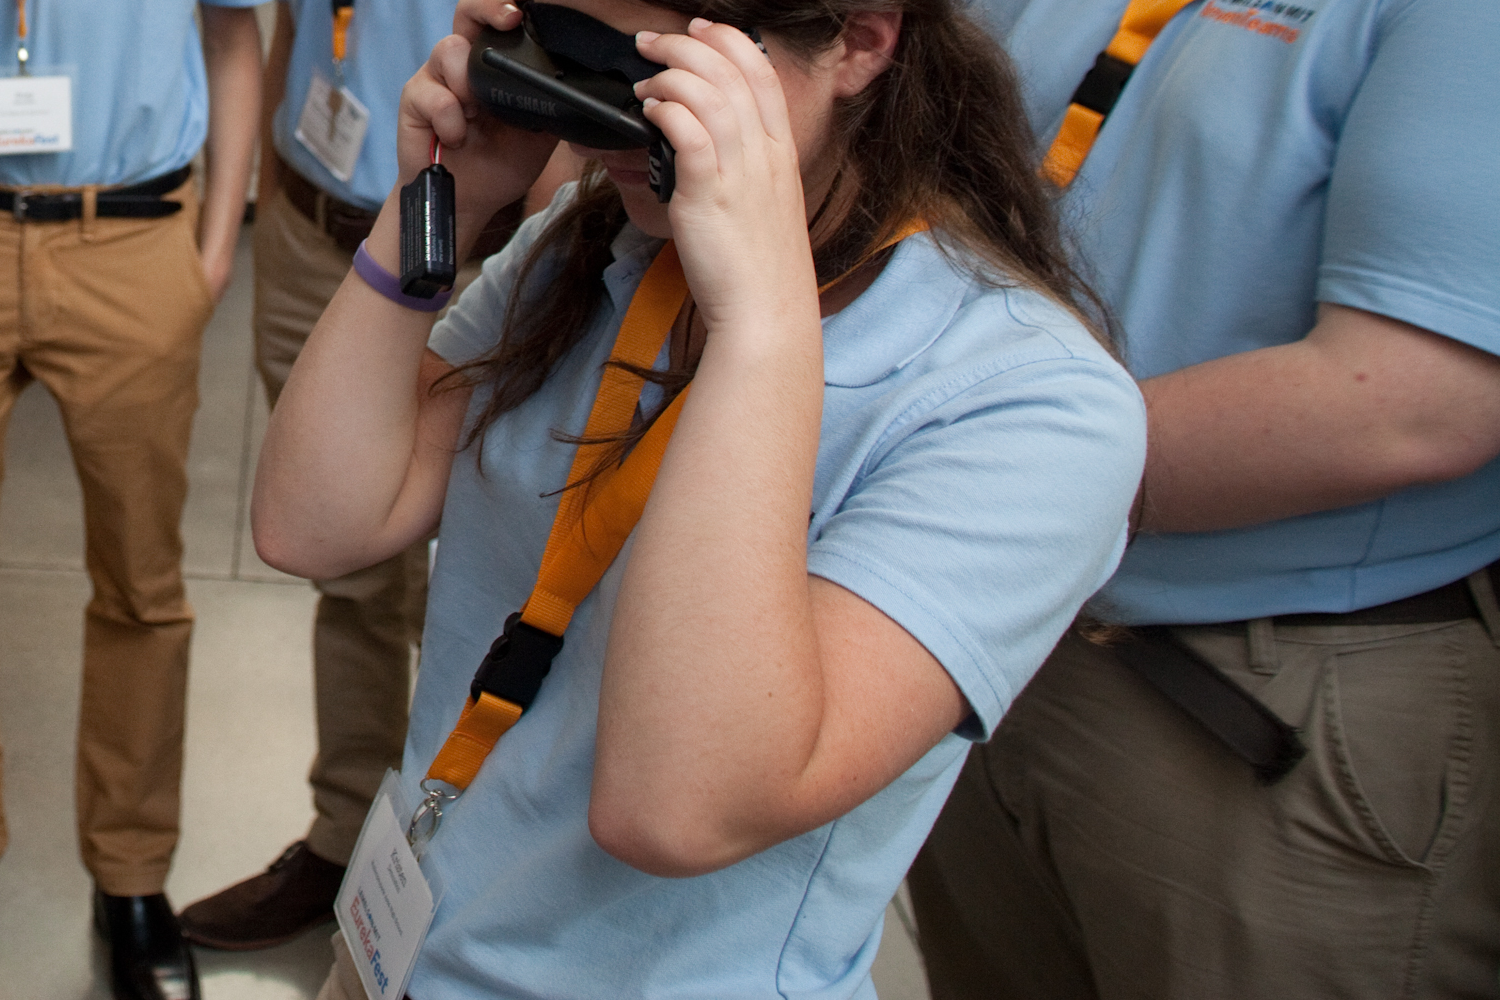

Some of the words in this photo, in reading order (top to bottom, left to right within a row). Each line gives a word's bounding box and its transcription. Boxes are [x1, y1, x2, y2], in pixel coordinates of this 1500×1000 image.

[490, 87, 514, 107] FAT
[515, 94, 558, 118] SHARK
[350, 895, 389, 995] EurekaFest
